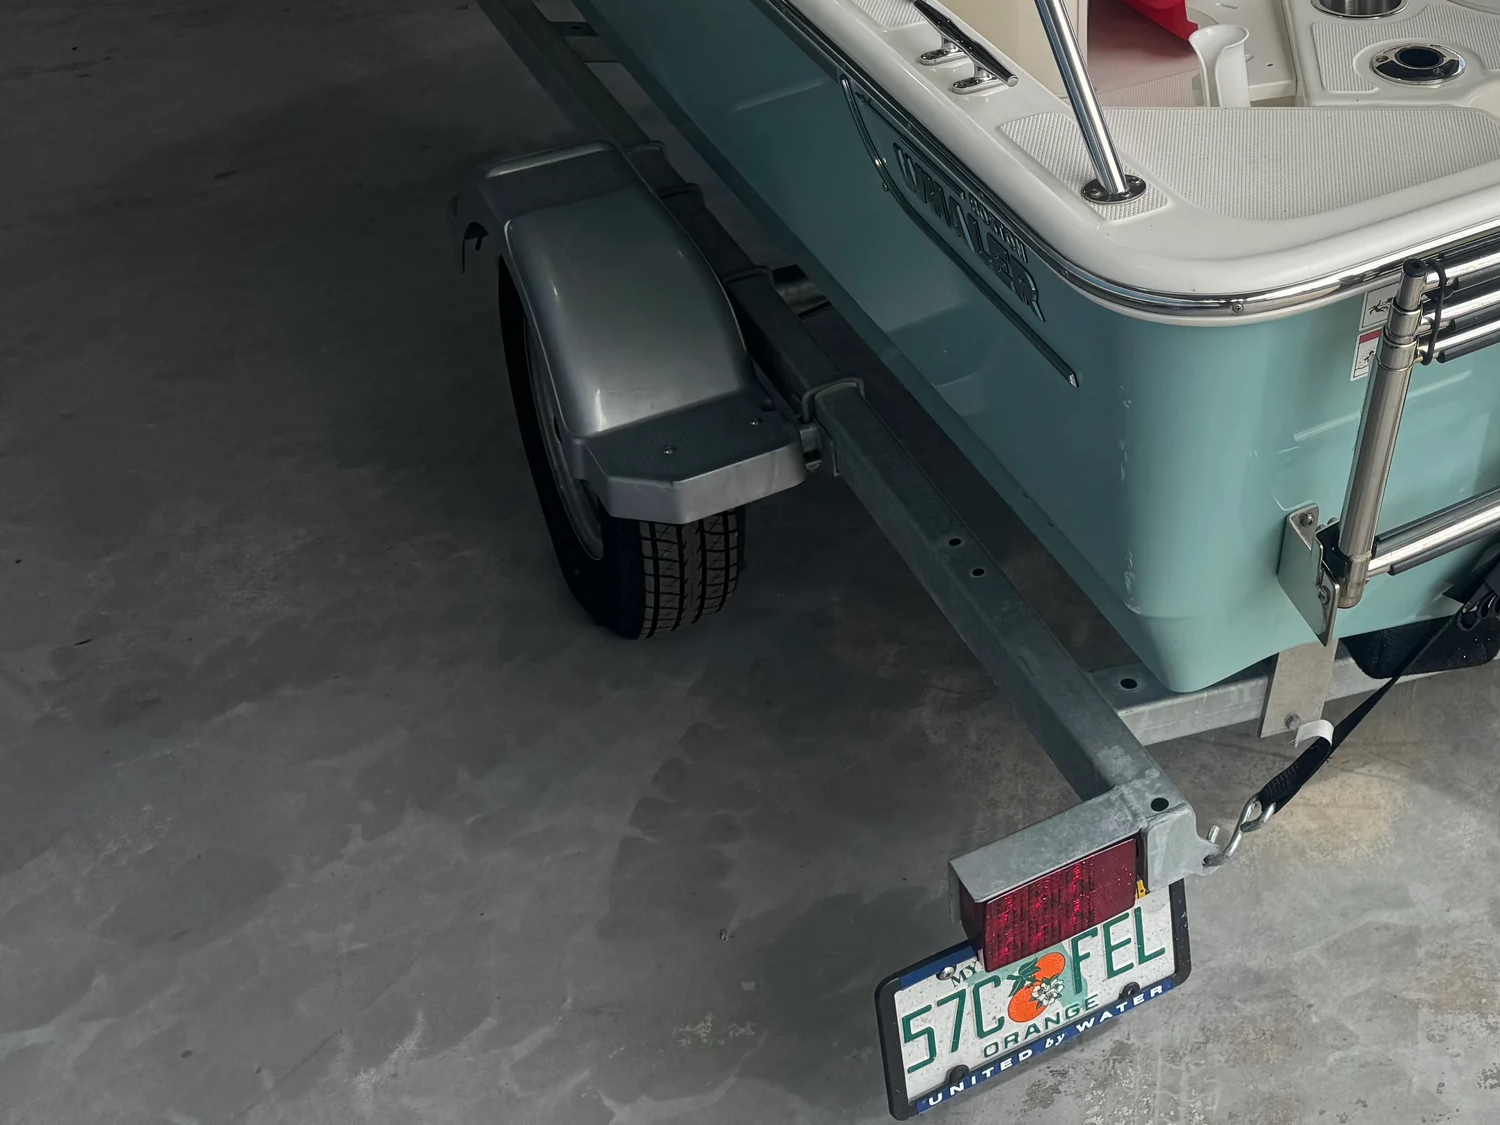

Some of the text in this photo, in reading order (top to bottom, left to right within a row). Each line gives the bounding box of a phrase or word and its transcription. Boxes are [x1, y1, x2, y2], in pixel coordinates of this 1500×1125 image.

[1072, 907, 1166, 994] FEL
[928, 985, 1163, 1106] UNITED by WATER
[984, 994, 1099, 1057] ORANGE
